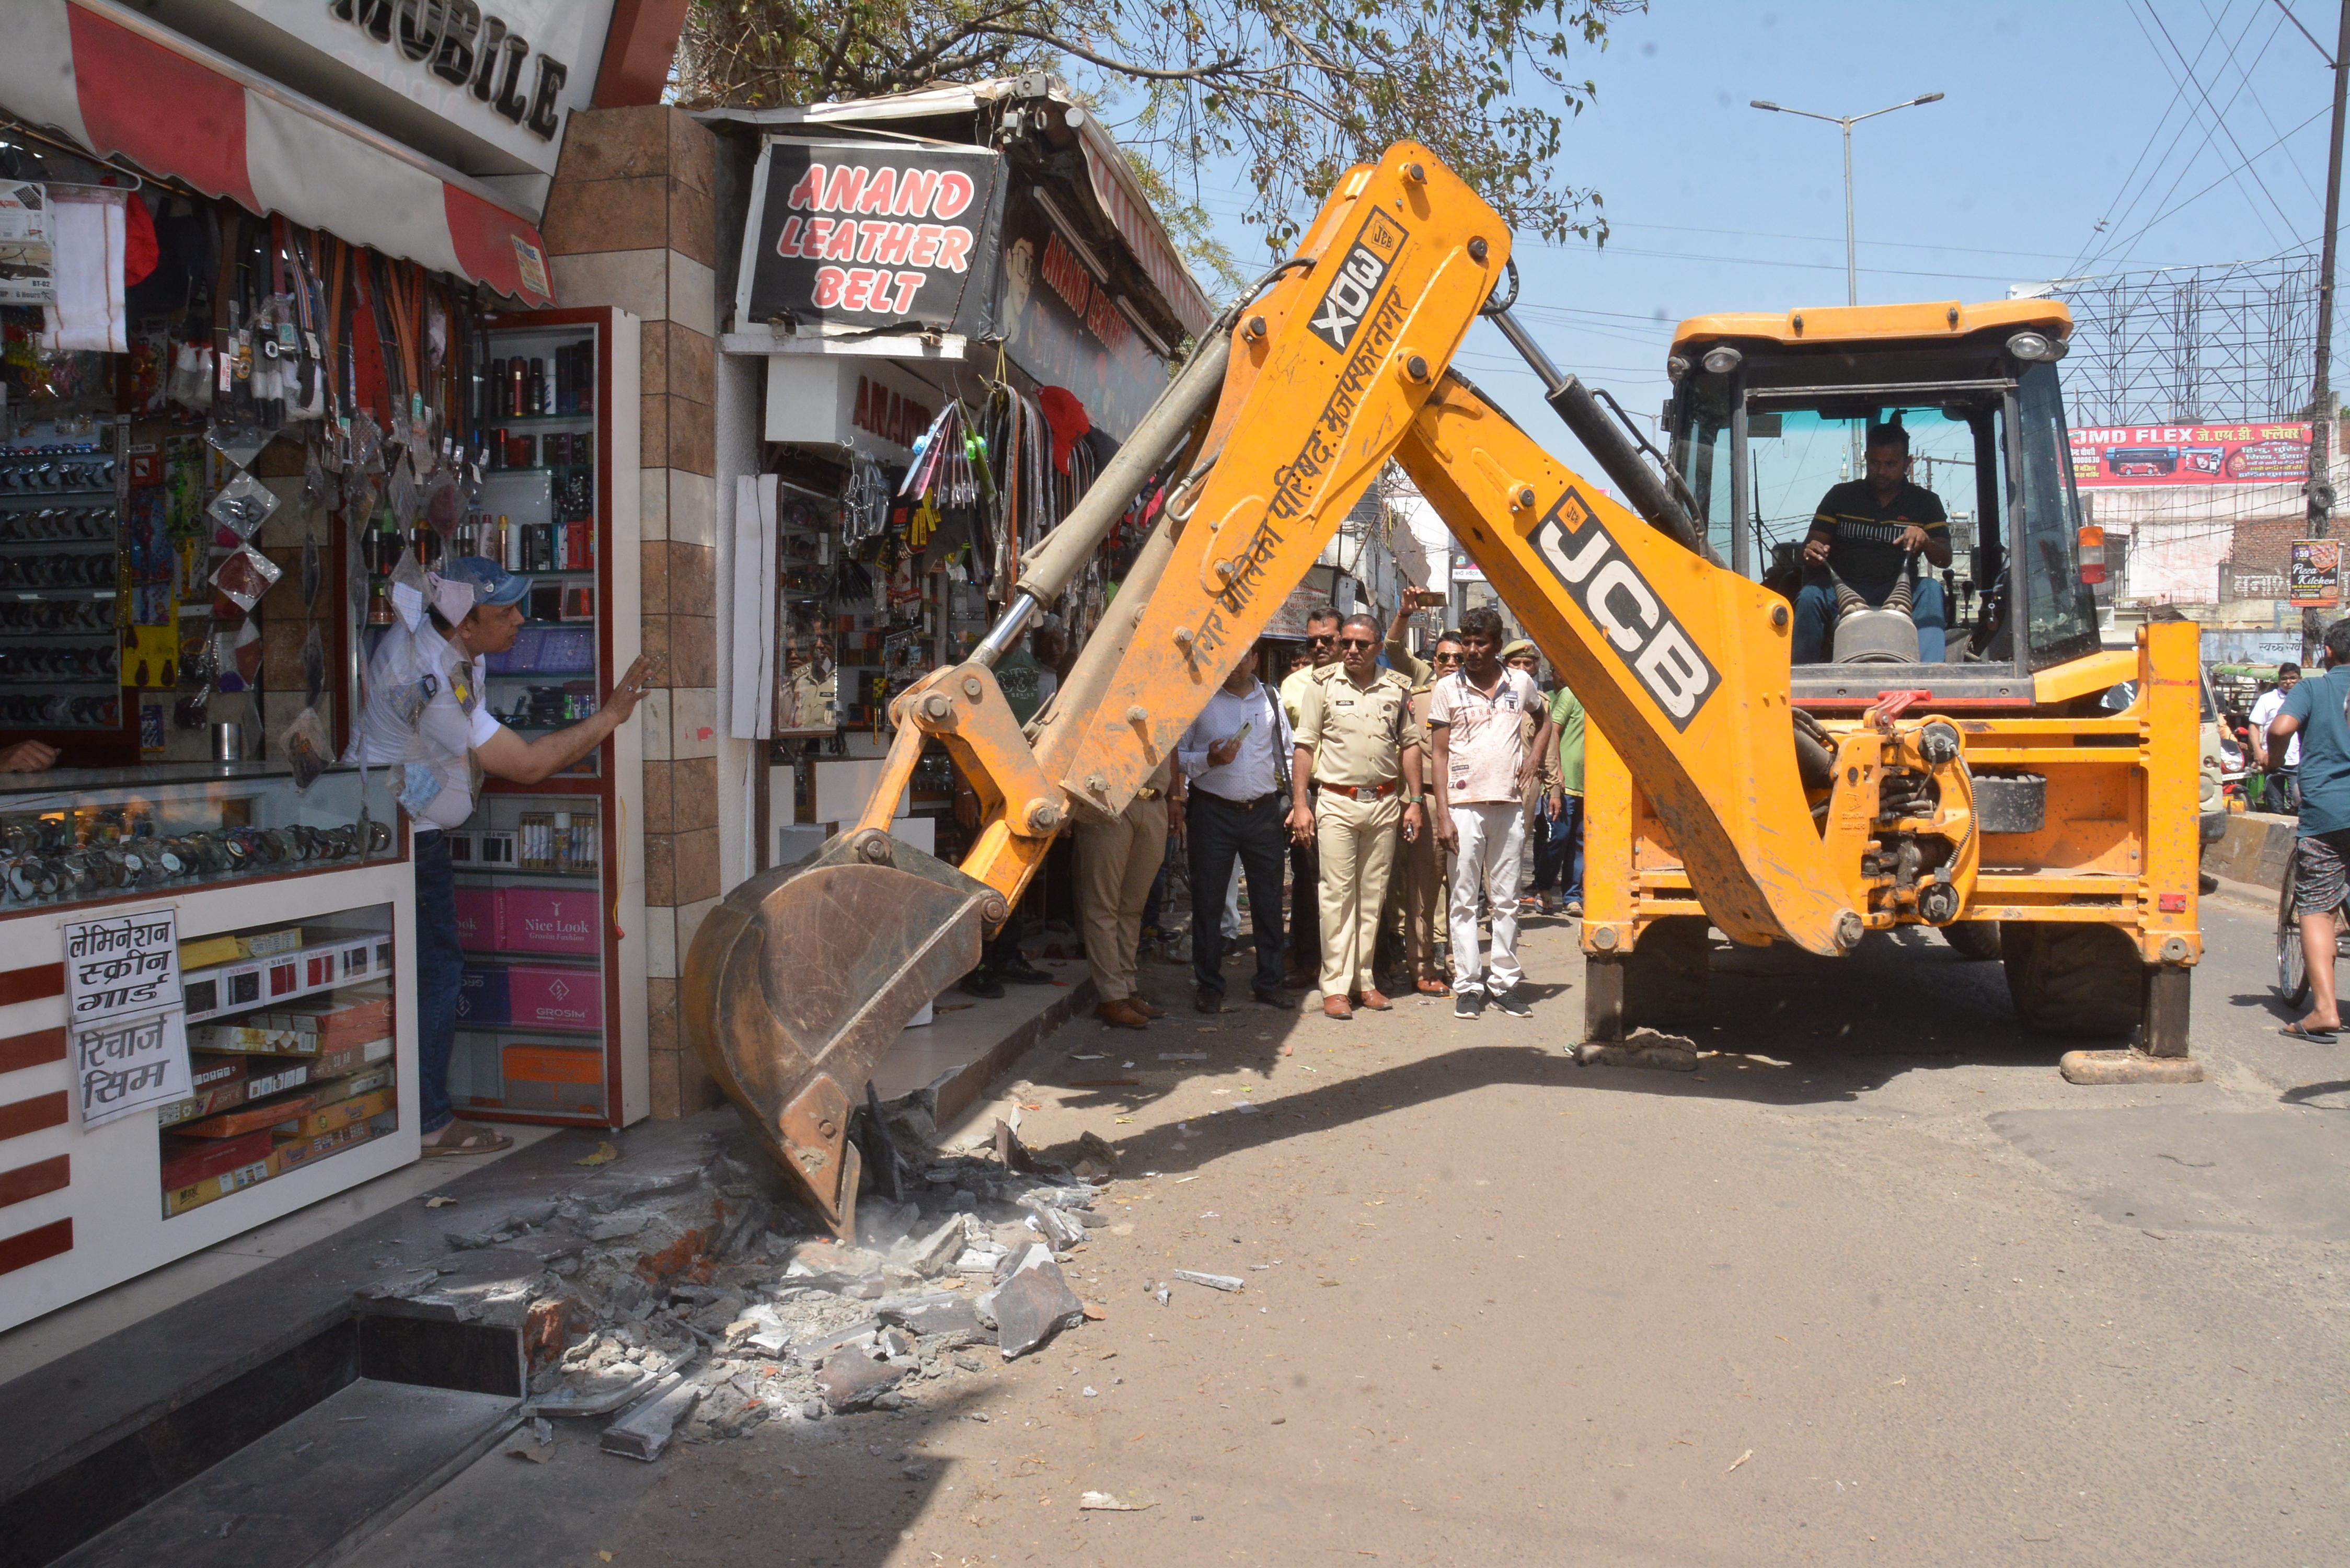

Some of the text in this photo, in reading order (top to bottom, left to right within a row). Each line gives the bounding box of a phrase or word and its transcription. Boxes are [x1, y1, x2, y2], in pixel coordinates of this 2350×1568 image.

[788, 164, 974, 220] ANAND
[777, 215, 973, 273] LEATHER
[1375, 225, 1393, 249] JCB
[1042, 230, 1089, 318] ANAND
[811, 266, 926, 314] BELT
[2074, 429, 2193, 444] JMD FLEX
[1566, 505, 1580, 524] JCB
[2293, 563, 2317, 574] Pizza
[2298, 575, 2336, 584] Kitchen
[1191, 608, 1229, 666] नगर
[1216, 517, 1285, 613] पालिका
[1540, 521, 1709, 718] JCB
[2259, 642, 2284, 653] स्वच्छ
[70, 919, 171, 958] लेमिनेशन
[457, 918, 477, 930] ook
[525, 919, 589, 933] Nice Look
[557, 933, 585, 941] Fashion
[79, 949, 172, 985] स्क्रीन
[77, 973, 170, 1011] गार्ड
[536, 1008, 585, 1019] GROSIM
[84, 1059, 170, 1110] सिम
